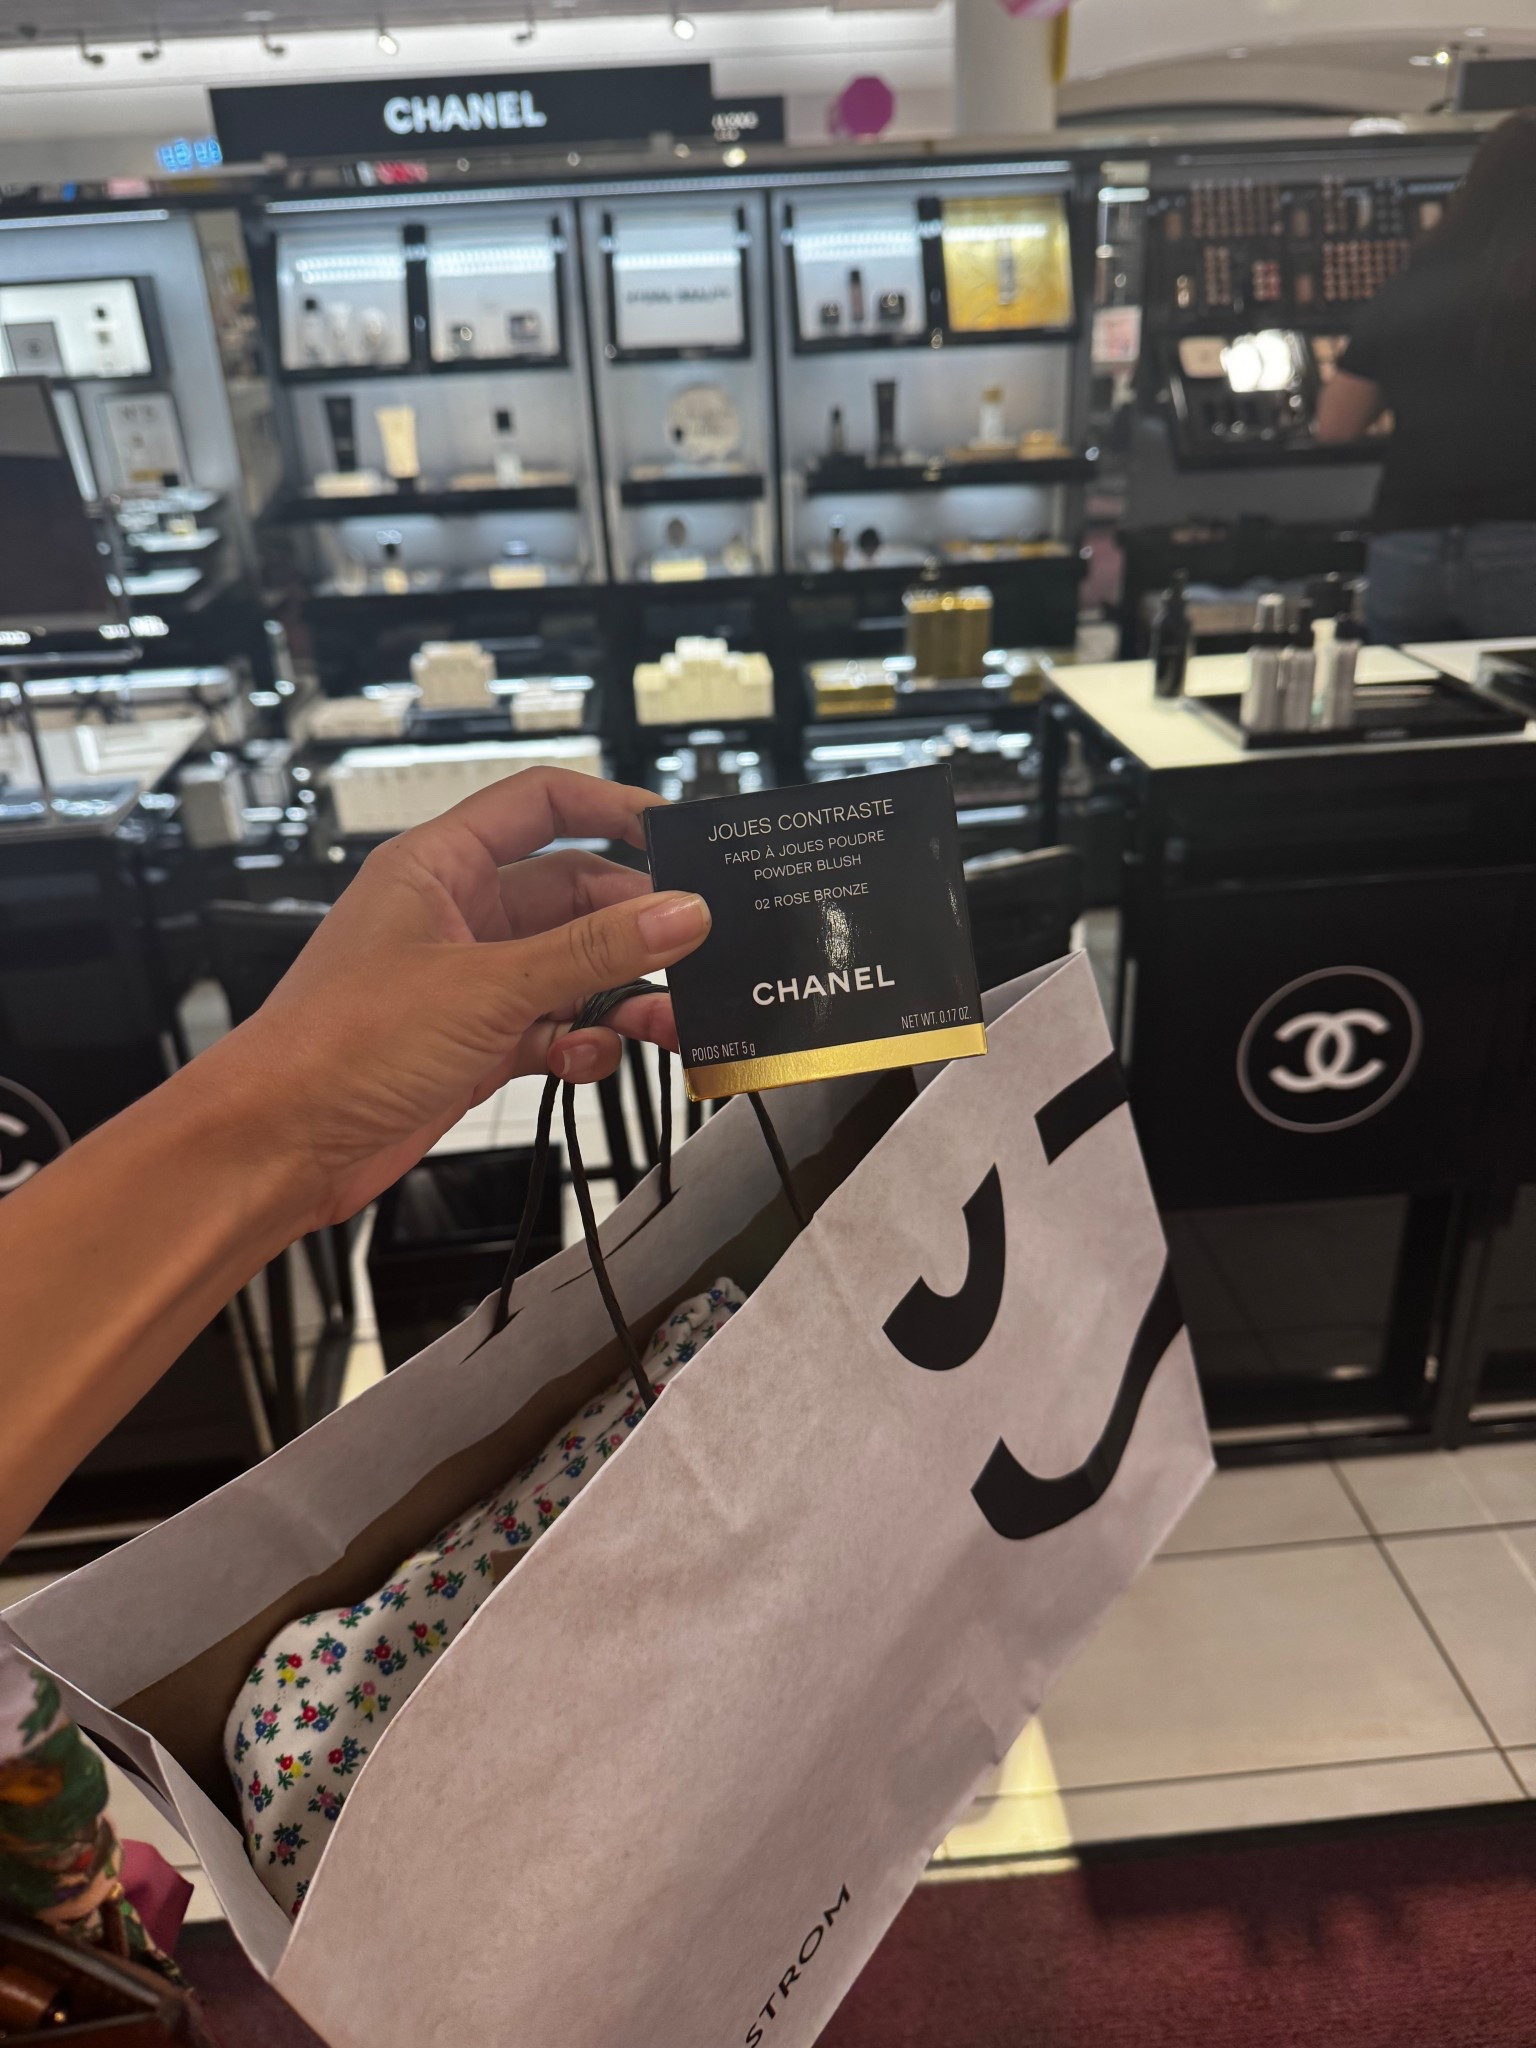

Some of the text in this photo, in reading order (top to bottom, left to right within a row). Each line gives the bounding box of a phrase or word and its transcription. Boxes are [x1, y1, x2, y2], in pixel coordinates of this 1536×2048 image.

[384, 90, 547, 134] CHANEL
[708, 798, 895, 842] JOUES CONTRASTE
[724, 829, 886, 865] FARD À JOUES POUDRE
[753, 853, 862, 881] POWDER BLUSH
[754, 882, 869, 911] 02 ROSE BRONZE
[752, 964, 896, 1006] CHANEL
[901, 1005, 972, 1030] NET WT. 0.17 OZ.
[691, 1041, 757, 1063] POIDS NET 5 g
